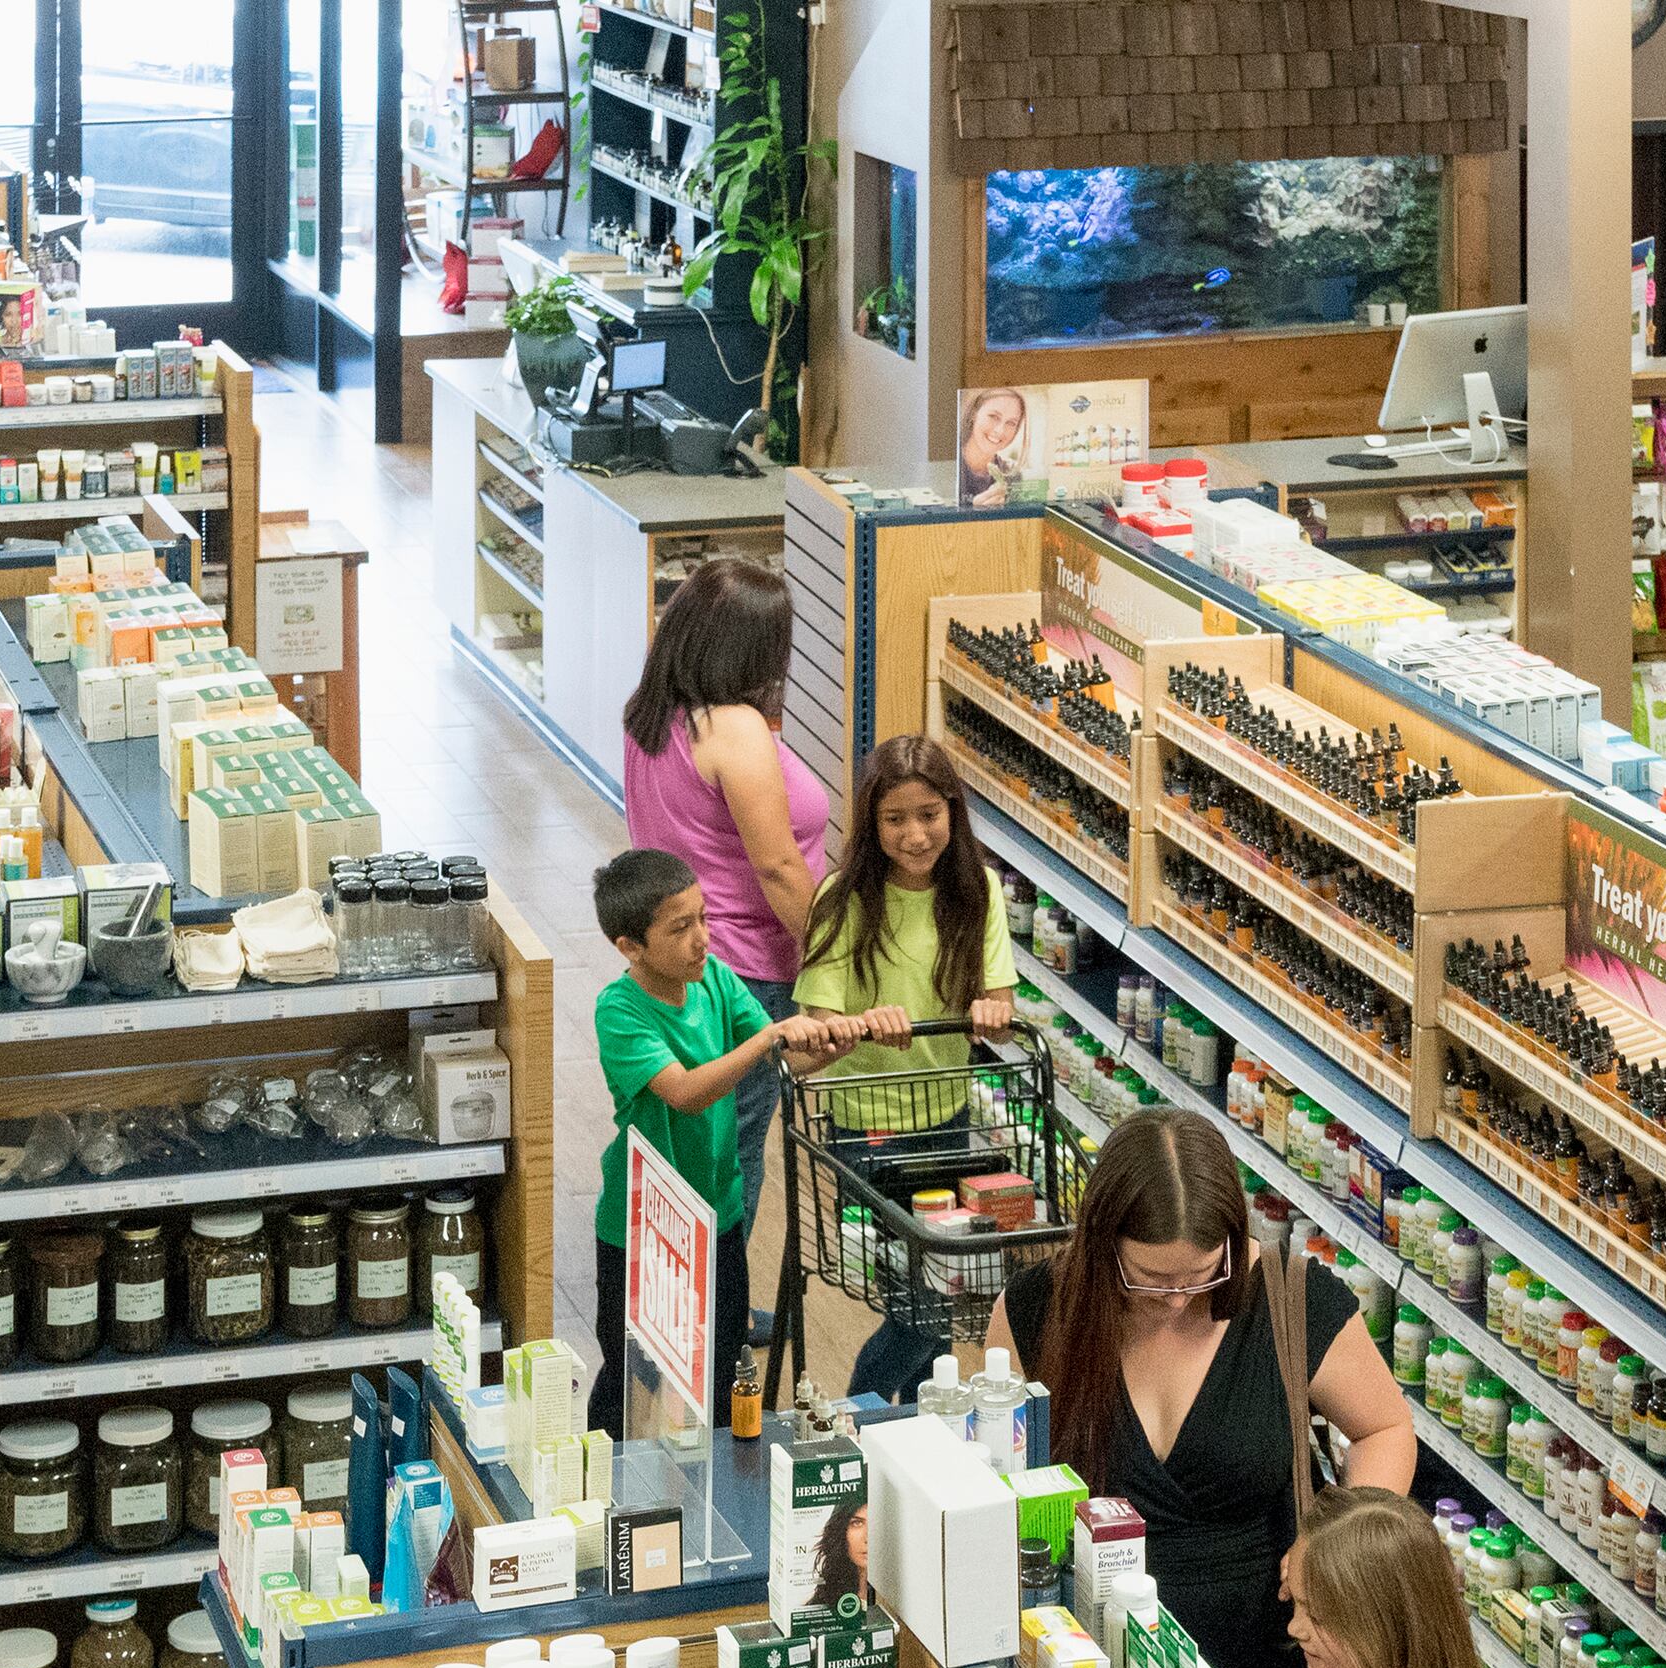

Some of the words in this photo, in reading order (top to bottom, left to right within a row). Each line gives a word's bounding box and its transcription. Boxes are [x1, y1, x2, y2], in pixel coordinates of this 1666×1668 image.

[1056, 558, 1085, 601] Treat
[1086, 580, 1135, 628] yourself
[1057, 604, 1086, 630] HERBAL
[1592, 863, 1643, 927] Treat
[1596, 925, 1642, 965] HERBAL
[466, 1071, 481, 1081] Herb
[483, 1070, 488, 1078] &
[489, 1070, 507, 1080] Spice
[646, 1177, 691, 1262] CLEARANCE
[644, 1227, 690, 1364] SALE
[795, 1482, 858, 1497] HERBATINT
[617, 1521, 630, 1590] LARÉNIM
[795, 1545, 807, 1555] 1N
[1098, 1548, 1124, 1561] Cough
[1125, 1548, 1133, 1557] &
[521, 1561, 528, 1569] &
[521, 1566, 541, 1576] SOAP
[1098, 1556, 1138, 1569] Bronchial
